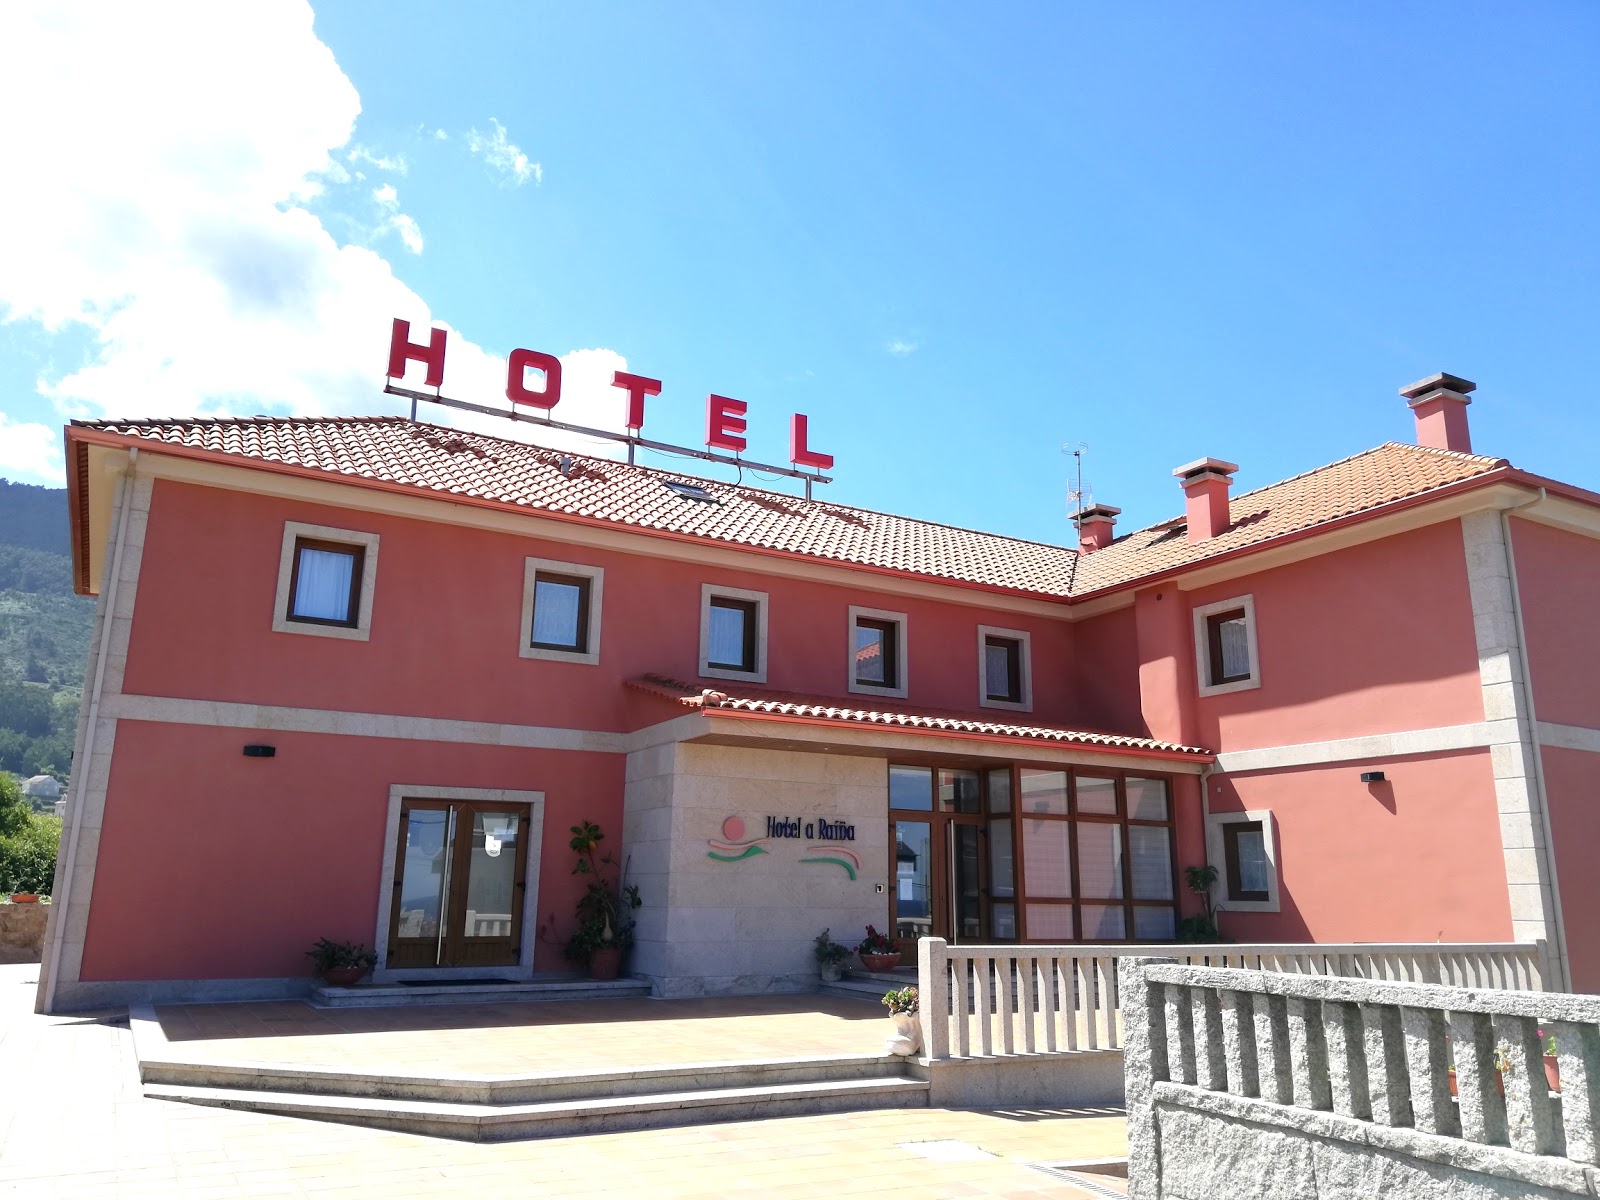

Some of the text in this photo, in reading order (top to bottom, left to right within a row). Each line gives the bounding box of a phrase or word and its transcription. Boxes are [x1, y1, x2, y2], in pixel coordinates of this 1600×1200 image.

[386, 317, 834, 469] HOTEL
[766, 815, 802, 839] Hotel
[805, 823, 814, 839] a
